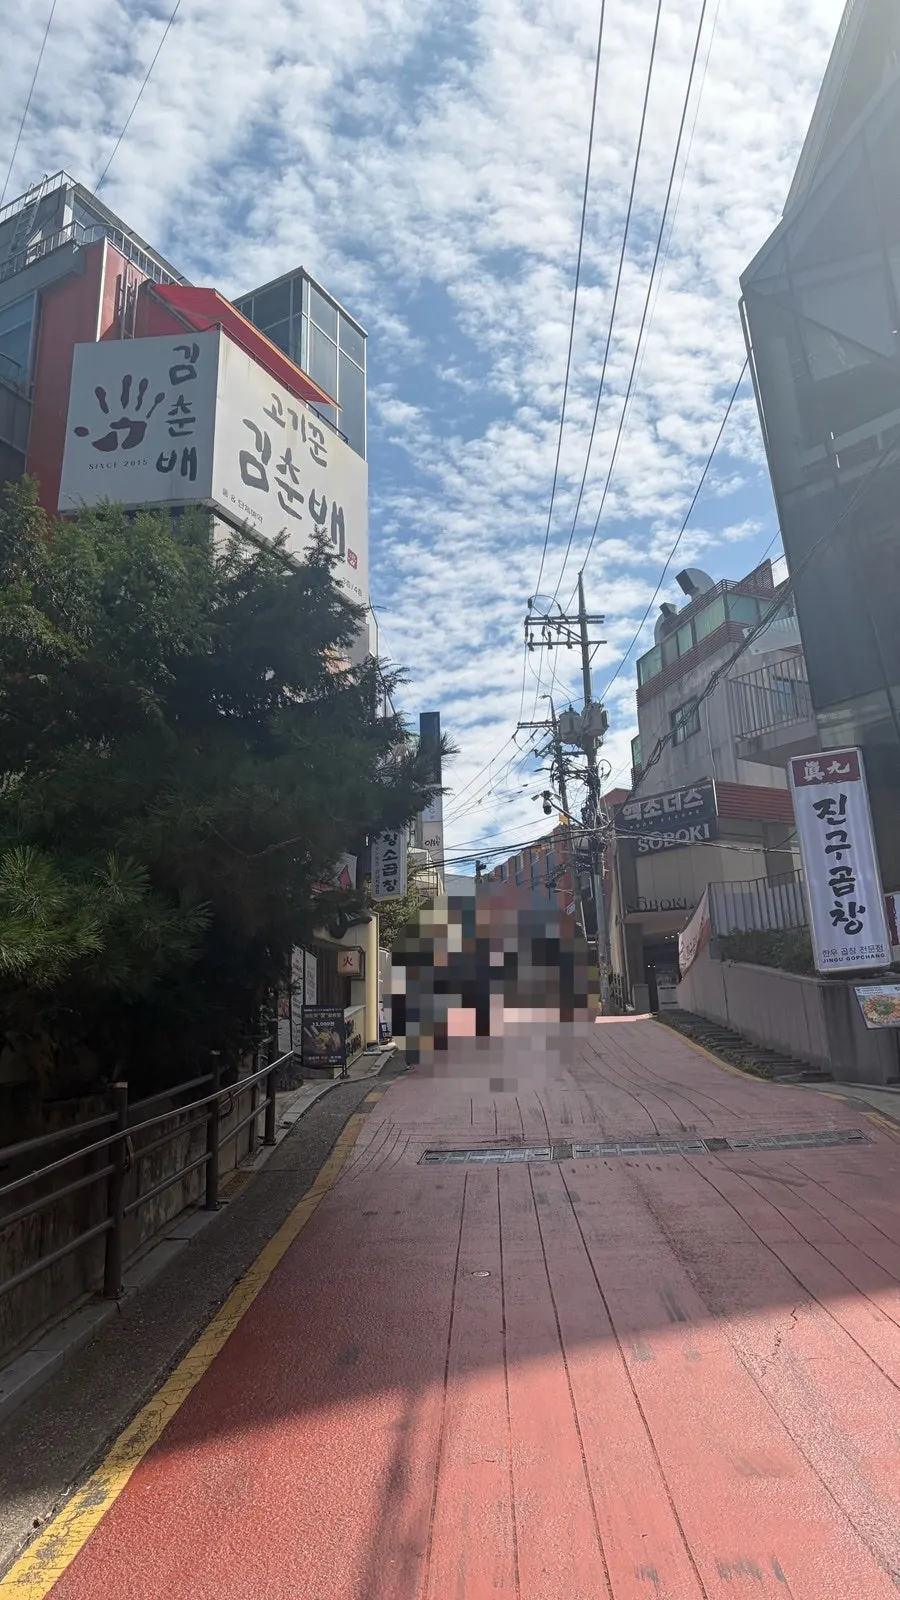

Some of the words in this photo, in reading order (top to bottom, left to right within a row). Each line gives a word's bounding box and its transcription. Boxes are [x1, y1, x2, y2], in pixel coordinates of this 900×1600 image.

[155, 343, 200, 482] 김춘배
[262, 392, 328, 469] 고기꾼
[88, 461, 117, 470] SINCE
[123, 459, 148, 467] 2015
[238, 417, 346, 557] 김춘배
[622, 787, 704, 820] 엑소더스
[637, 823, 711, 853] SOBOKI
[811, 792, 866, 935] 진구곱창
[342, 956, 354, 967] 火
[822, 948, 839, 958] 한우
[859, 943, 884, 954] 전문점
[846, 952, 886, 961] GOPCHANG
